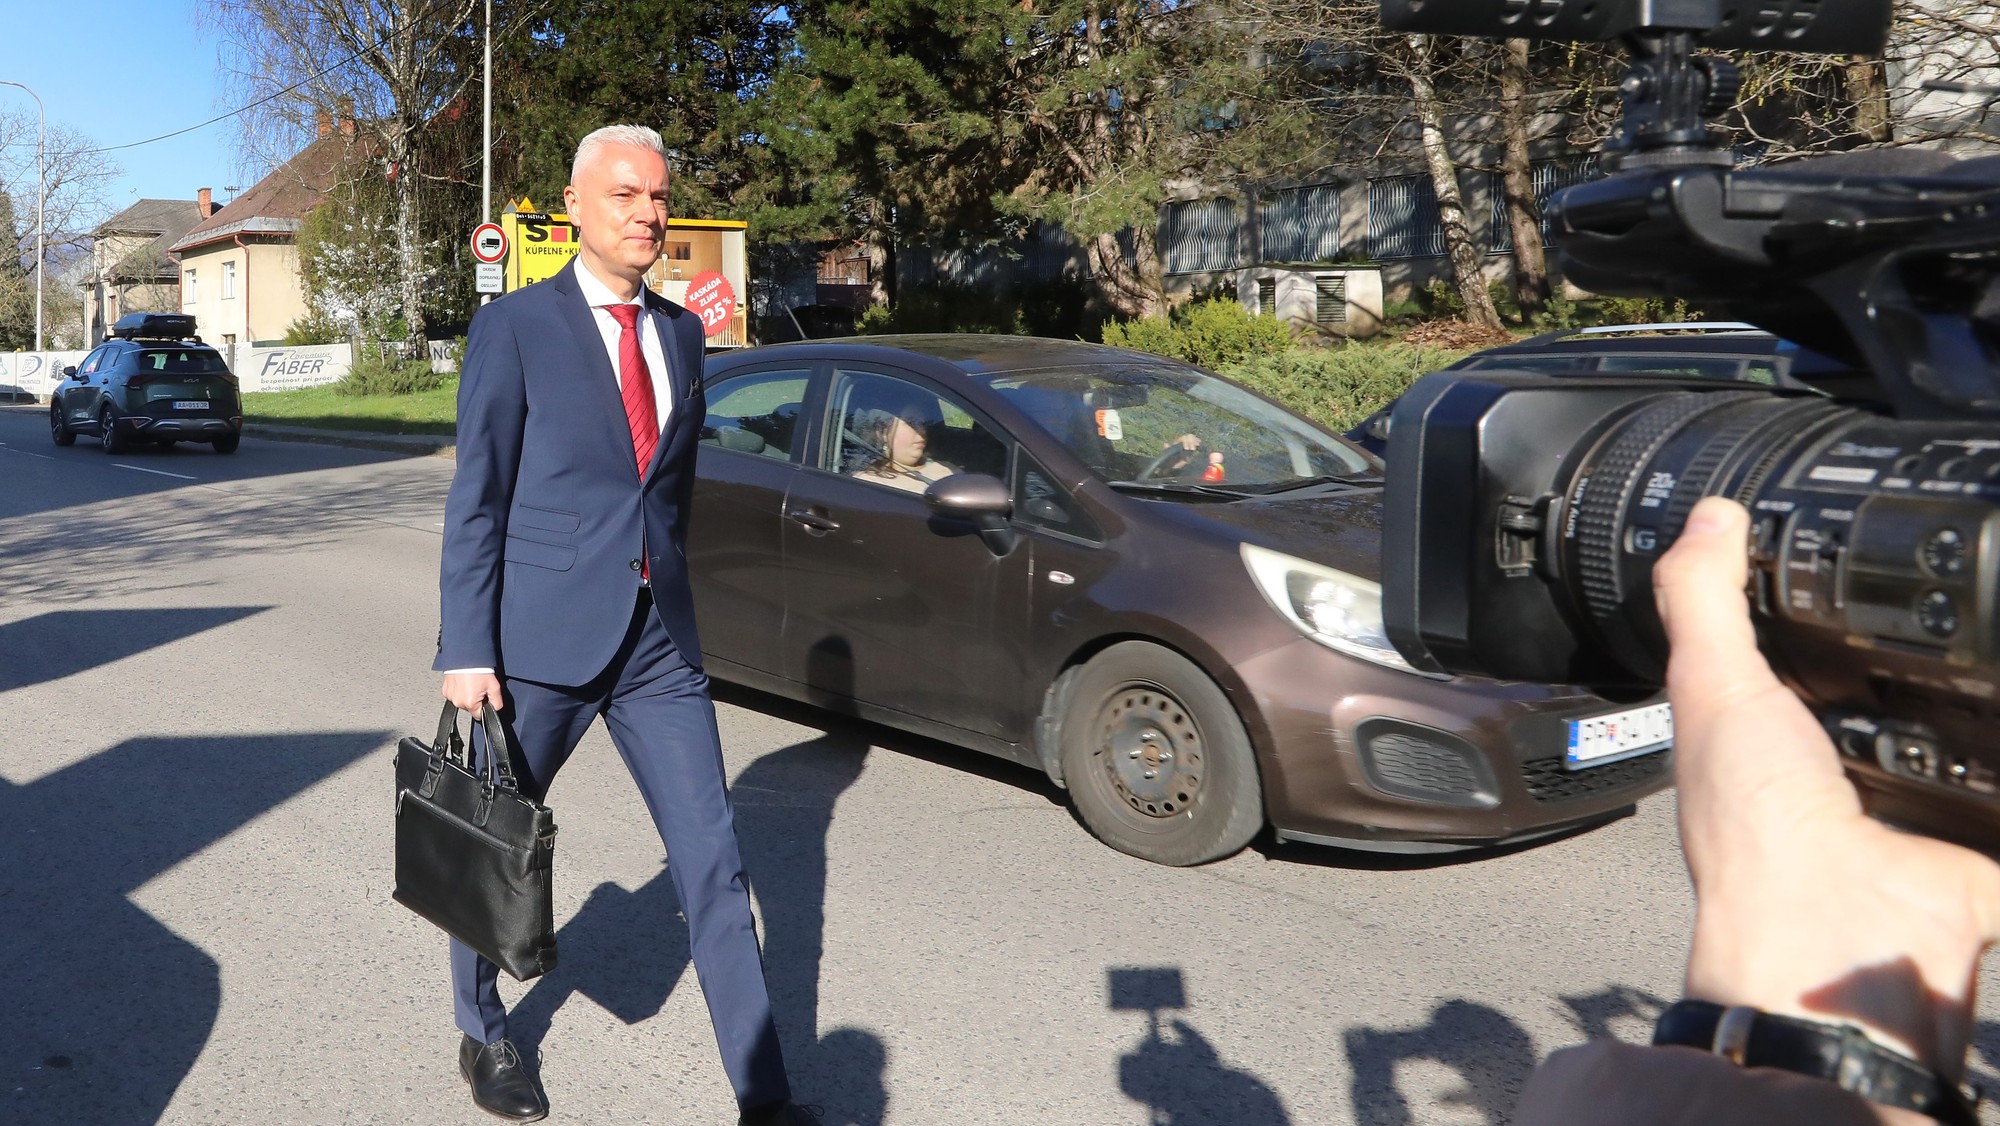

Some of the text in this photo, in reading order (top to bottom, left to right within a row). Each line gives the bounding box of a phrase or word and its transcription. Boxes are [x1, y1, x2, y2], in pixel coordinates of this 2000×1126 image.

[525, 244, 581, 255] KÚPEĽNE KU
[689, 277, 722, 302] KASKÁDA
[698, 290, 718, 307] ZLIAV
[260, 352, 325, 377] FÁBER
[1563, 477, 1589, 538] Sony Lens
[1634, 530, 1657, 550] G
